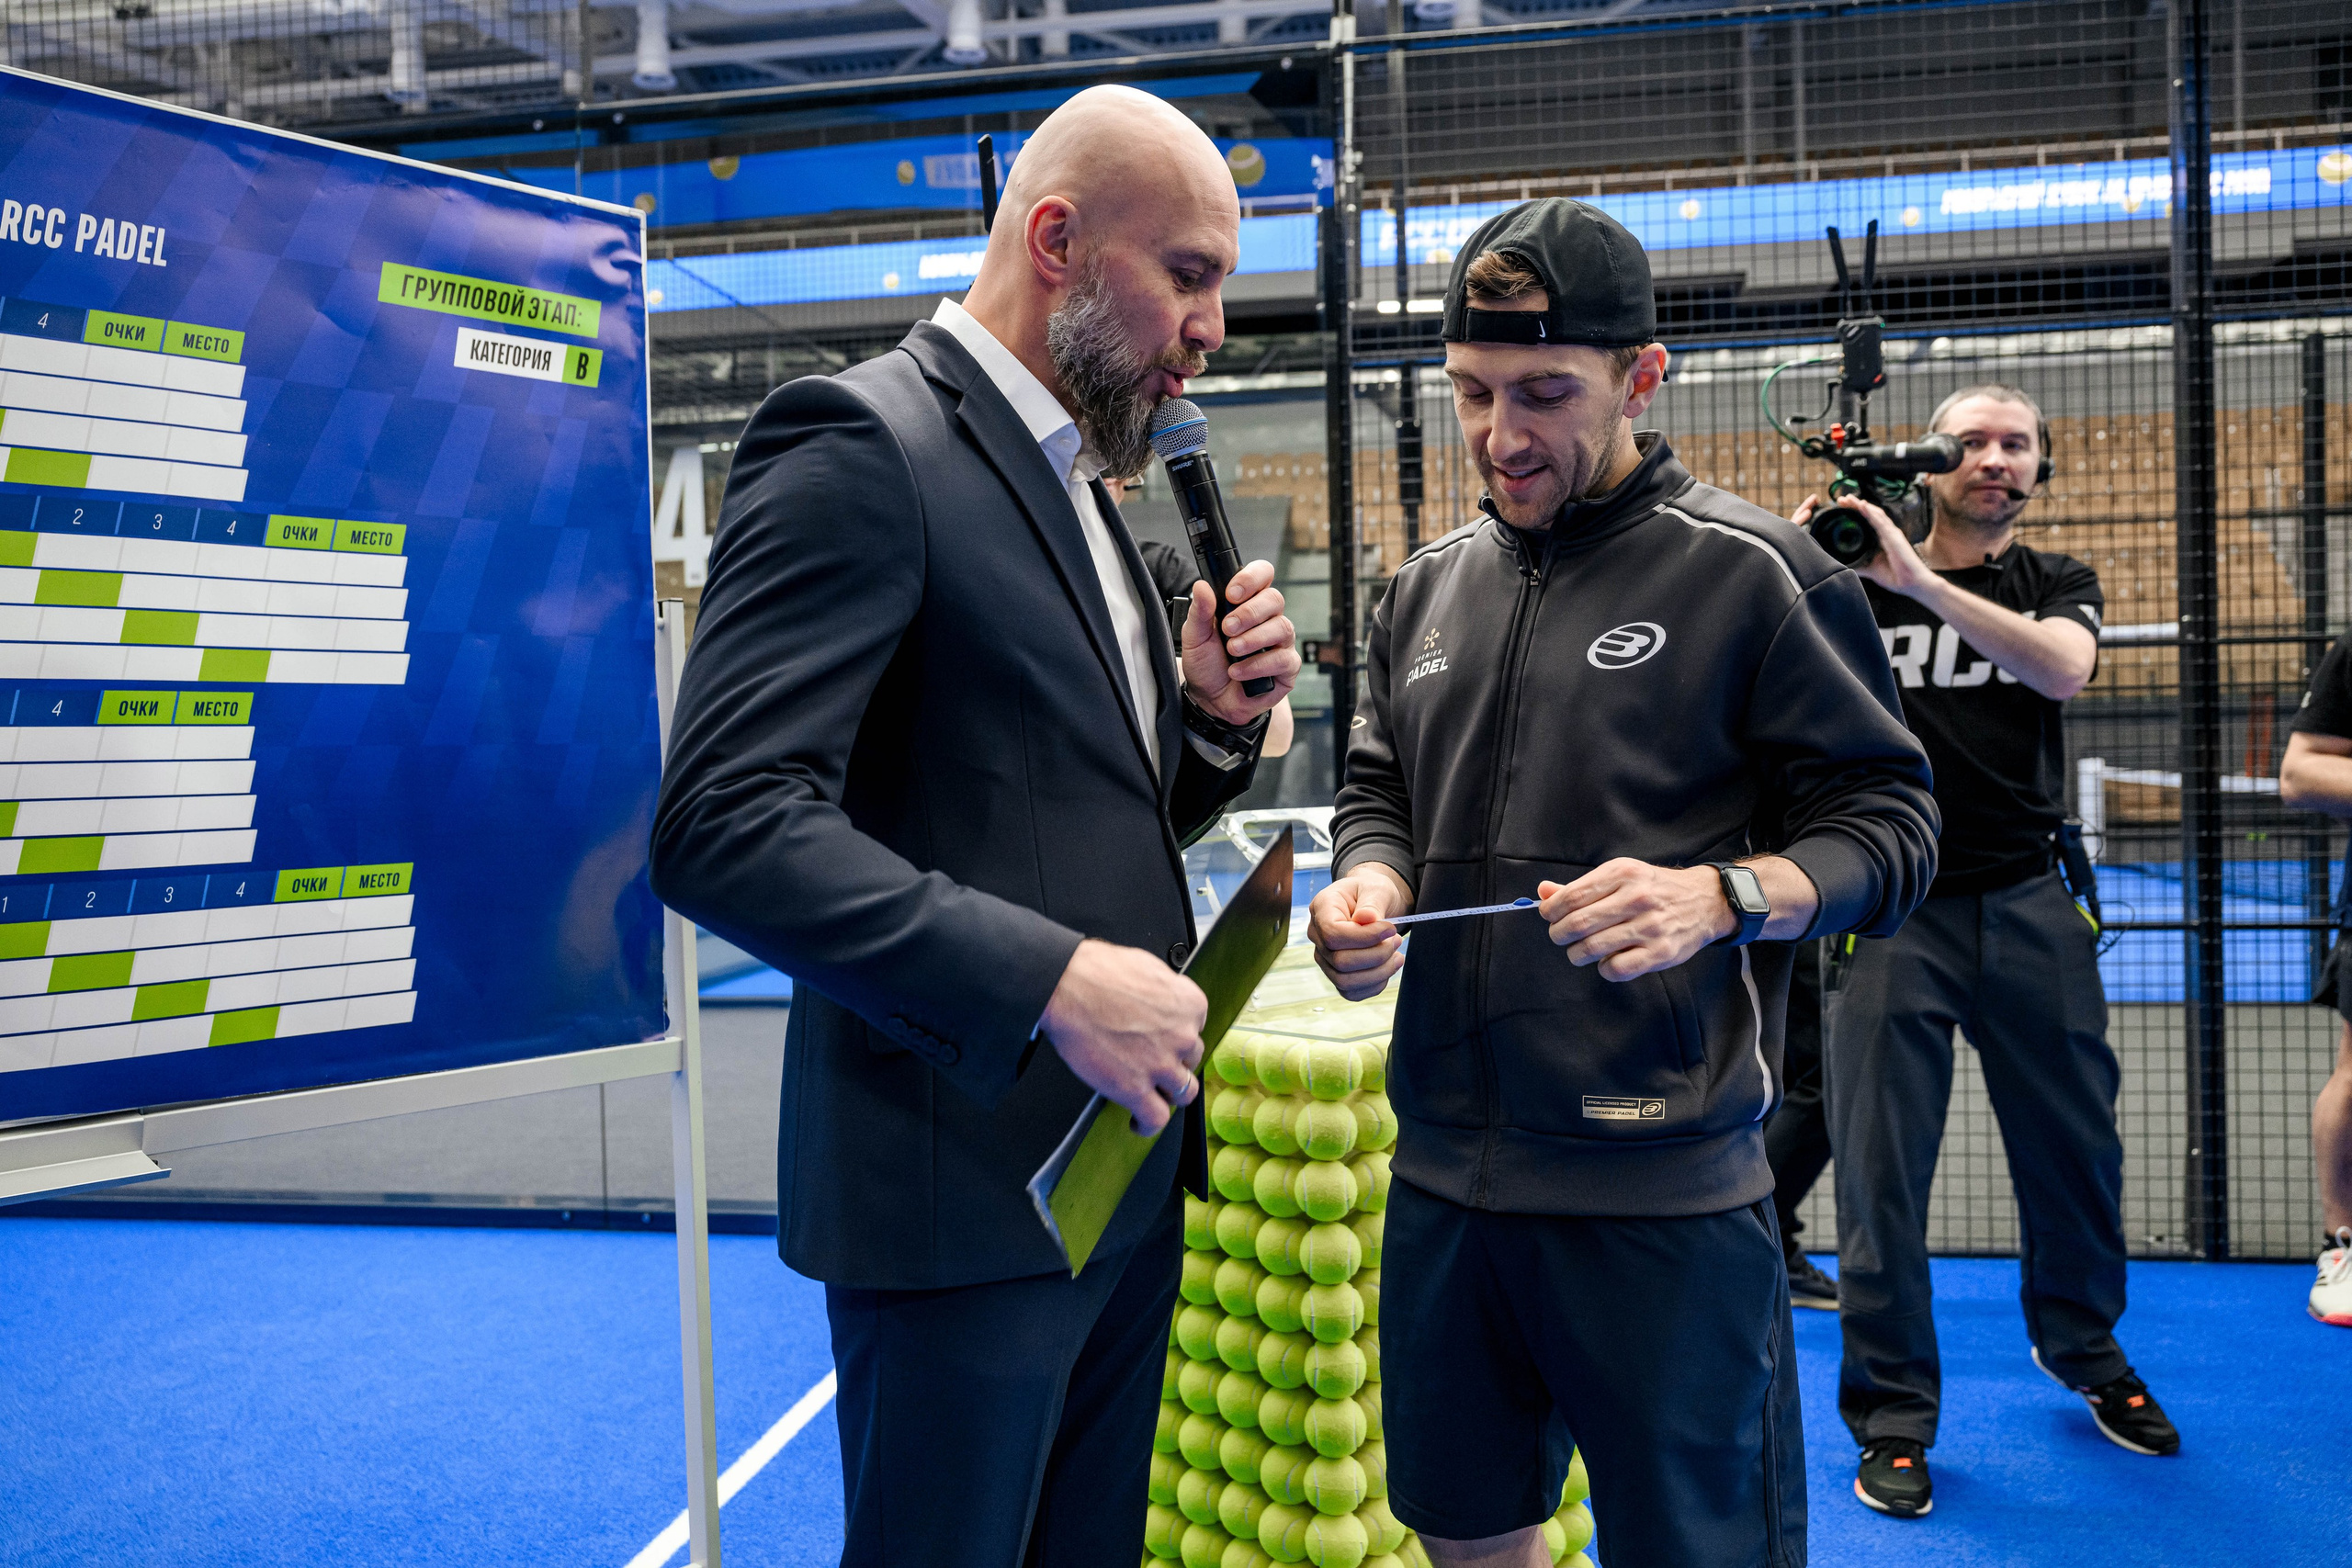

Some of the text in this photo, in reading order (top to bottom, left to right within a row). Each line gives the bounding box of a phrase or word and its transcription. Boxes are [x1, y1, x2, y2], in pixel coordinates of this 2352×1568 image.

[0, 198, 167, 266] RCC PADEL
[401, 274, 582, 327] ГРУППОВОЙ ЭТАП:
[37, 312, 230, 354] 4 ОЧКИ МЕСТО
[469, 338, 552, 371] КАТЕГОРИЯ
[73, 508, 393, 547] 2 3 4 ОЧКИ МЕСТО
[1414, 649, 1442, 664] PREMIER
[1879, 610, 2037, 688] RC
[1406, 656, 1449, 687] PADEL
[51, 700, 239, 717] 4 ОЧКИ МЕСТО
[1, 872, 401, 913] 1 2 3 4 ОЧКИ МЕСТО
